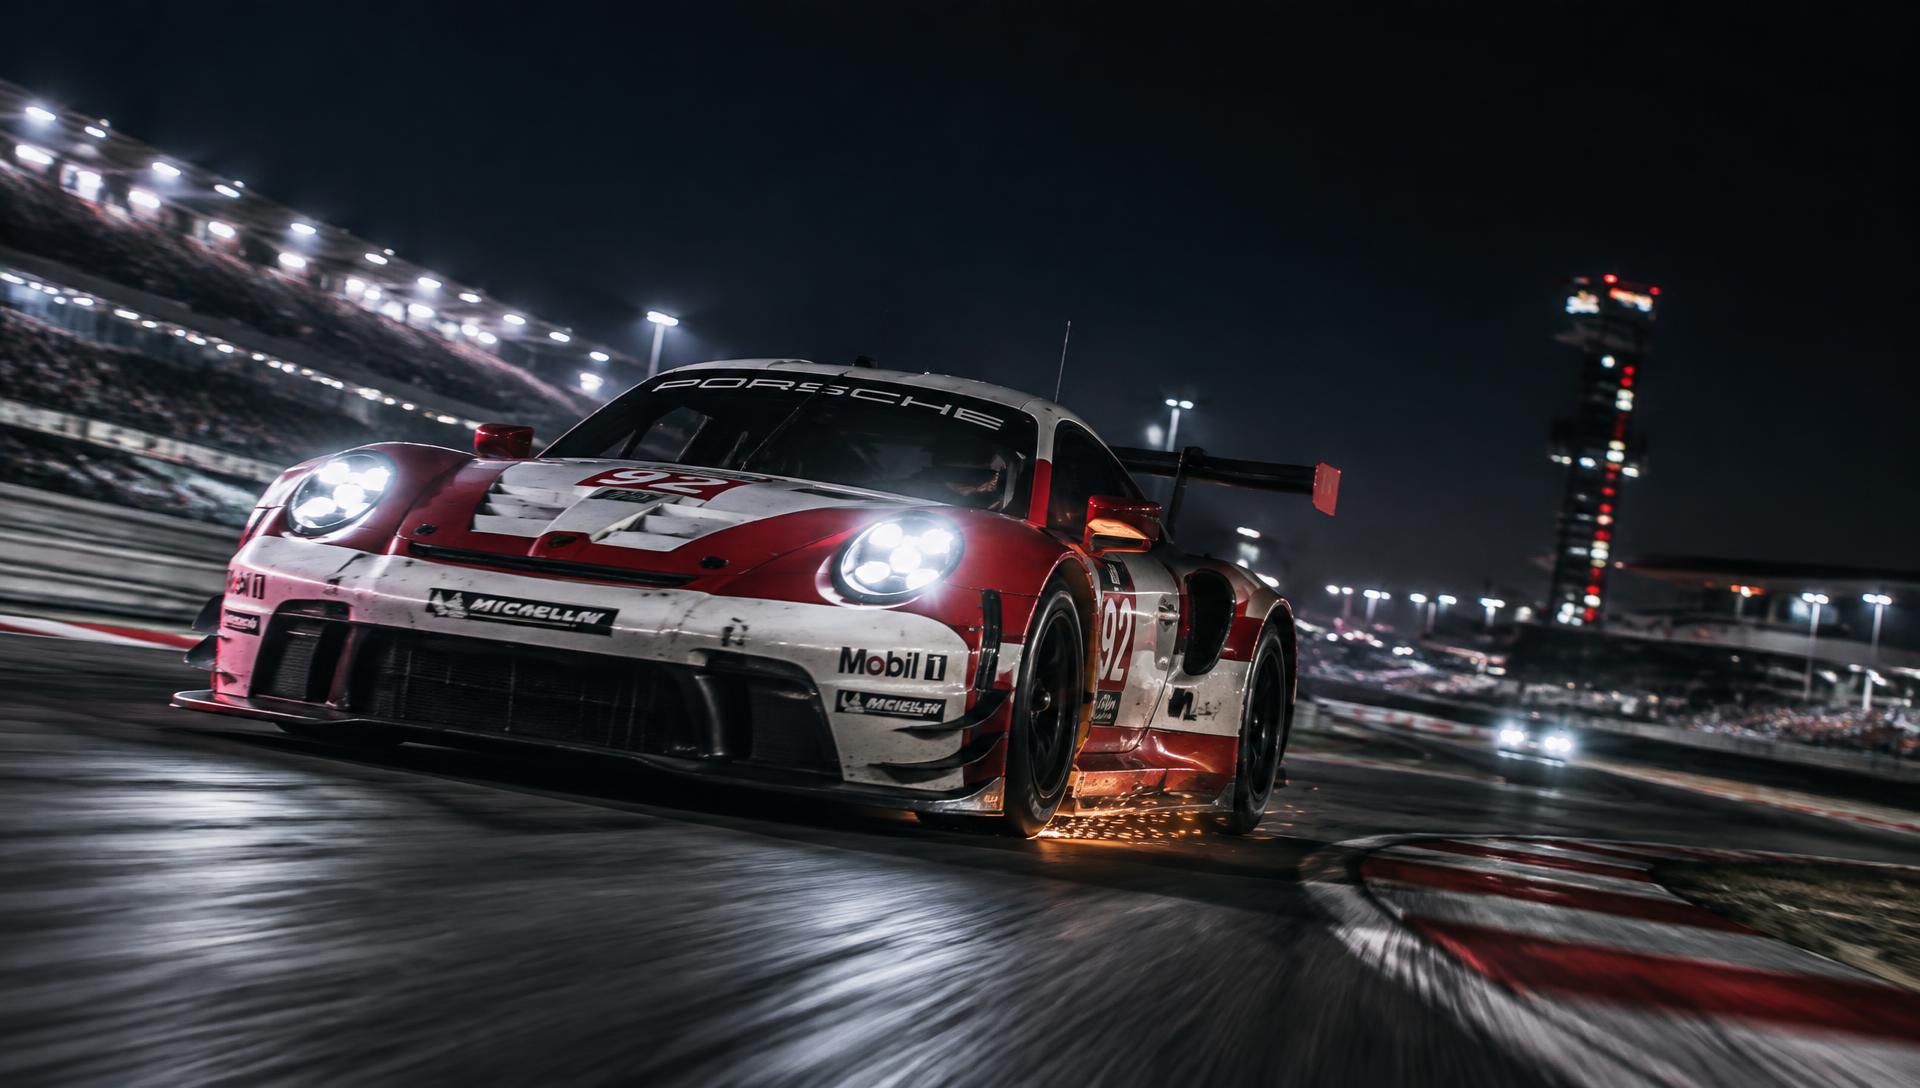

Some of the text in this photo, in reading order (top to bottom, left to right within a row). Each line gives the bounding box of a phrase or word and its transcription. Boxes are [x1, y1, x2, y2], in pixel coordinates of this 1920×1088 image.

[652, 378, 1004, 430] PORSCHE
[597, 471, 729, 494] 92
[1100, 597, 1132, 682] 92
[838, 647, 919, 679] Mobil
